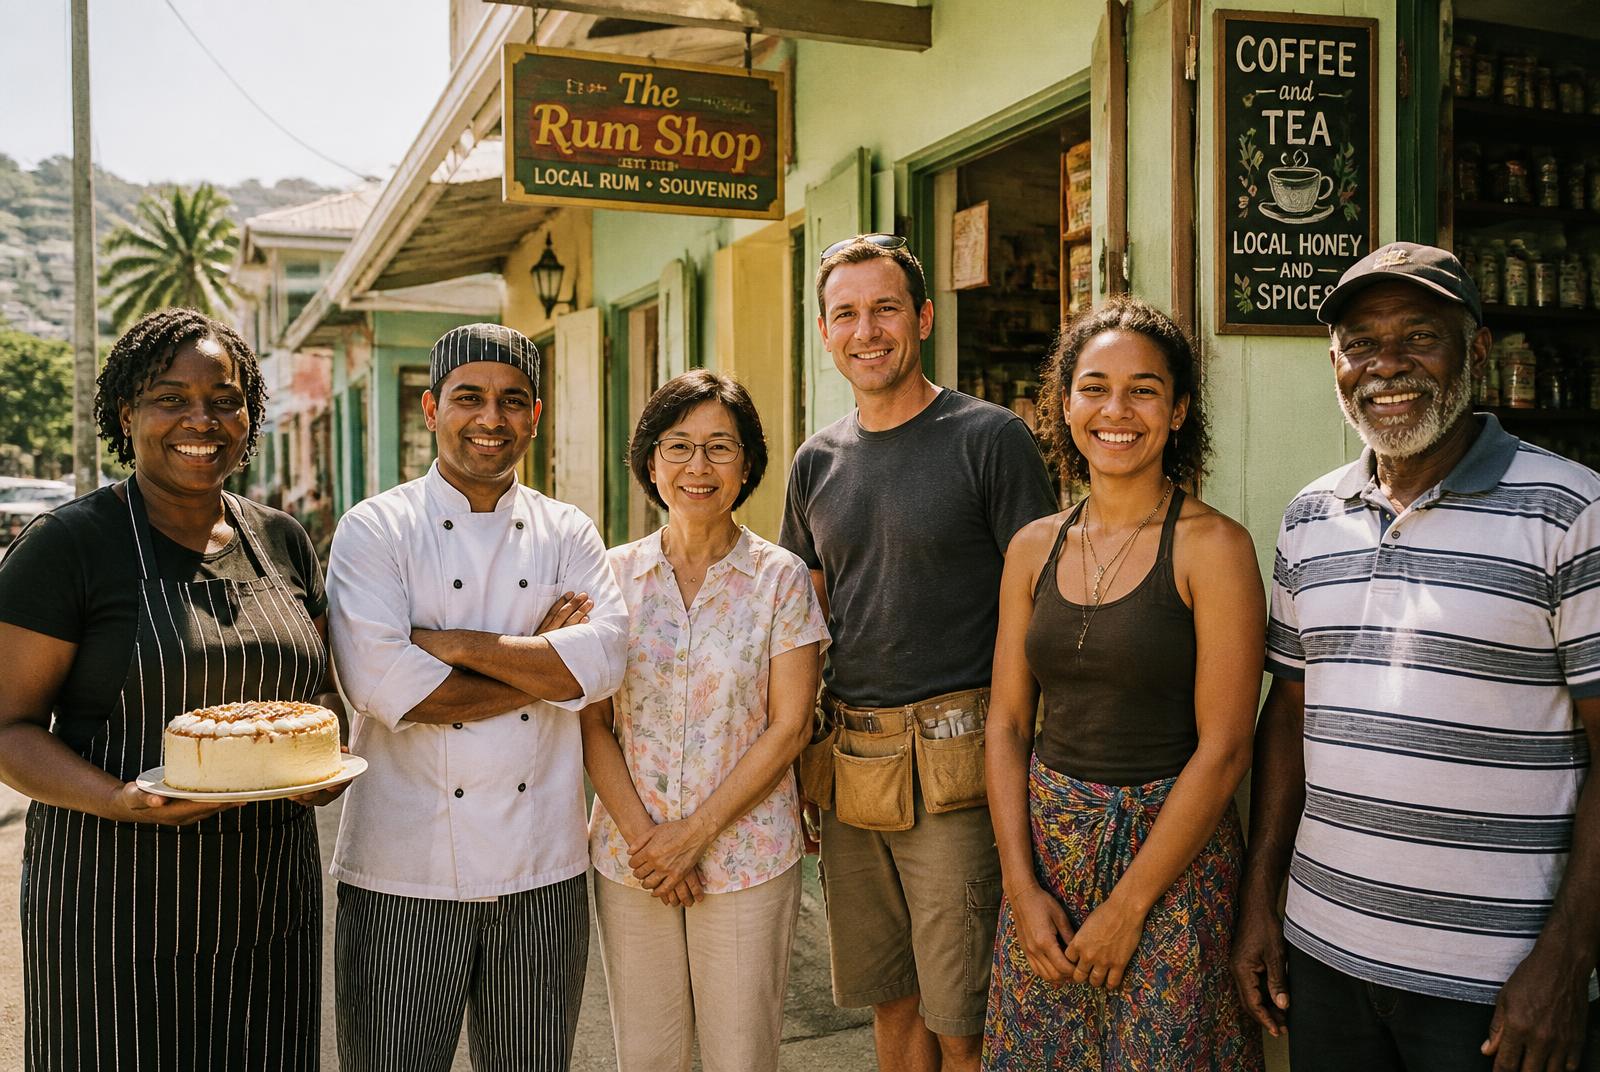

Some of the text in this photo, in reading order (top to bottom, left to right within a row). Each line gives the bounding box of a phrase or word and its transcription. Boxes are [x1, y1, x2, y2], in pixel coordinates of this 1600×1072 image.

[1236, 35, 1357, 78] COFFEE
[618, 72, 680, 108] The
[1279, 80, 1315, 102] and
[533, 103, 761, 174] Rum Shop
[1261, 109, 1332, 147] TEA
[534, 167, 758, 200] LOCAL RUM SOUVENIRS
[1233, 230, 1362, 257] LOCAL HONEY
[1279, 262, 1314, 278] AND
